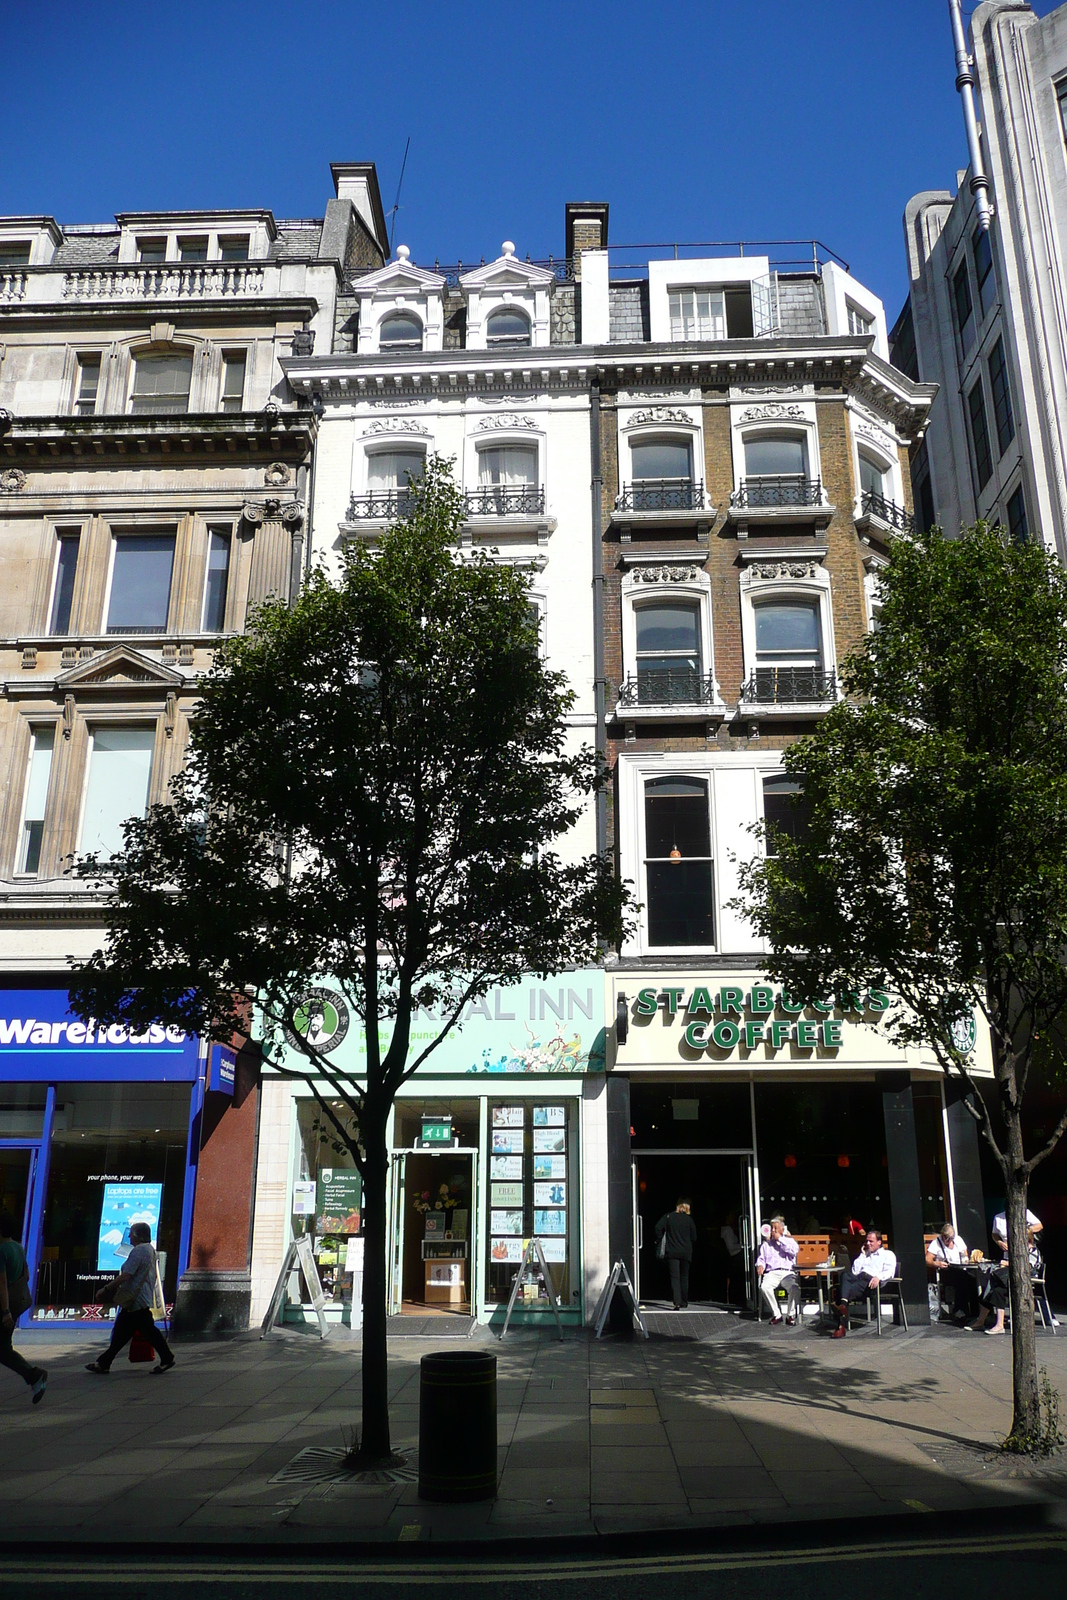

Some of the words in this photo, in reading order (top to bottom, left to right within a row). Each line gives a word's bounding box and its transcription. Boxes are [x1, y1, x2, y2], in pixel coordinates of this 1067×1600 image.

[529, 988, 594, 1021] INN
[0, 1016, 186, 1045] Warehouse
[685, 1019, 844, 1049] COFFEE
[100, 1174, 119, 1182] phone,
[107, 1187, 132, 1196] Laptops
[146, 1187, 158, 1195] free
[498, 1187, 516, 1195] FREE
